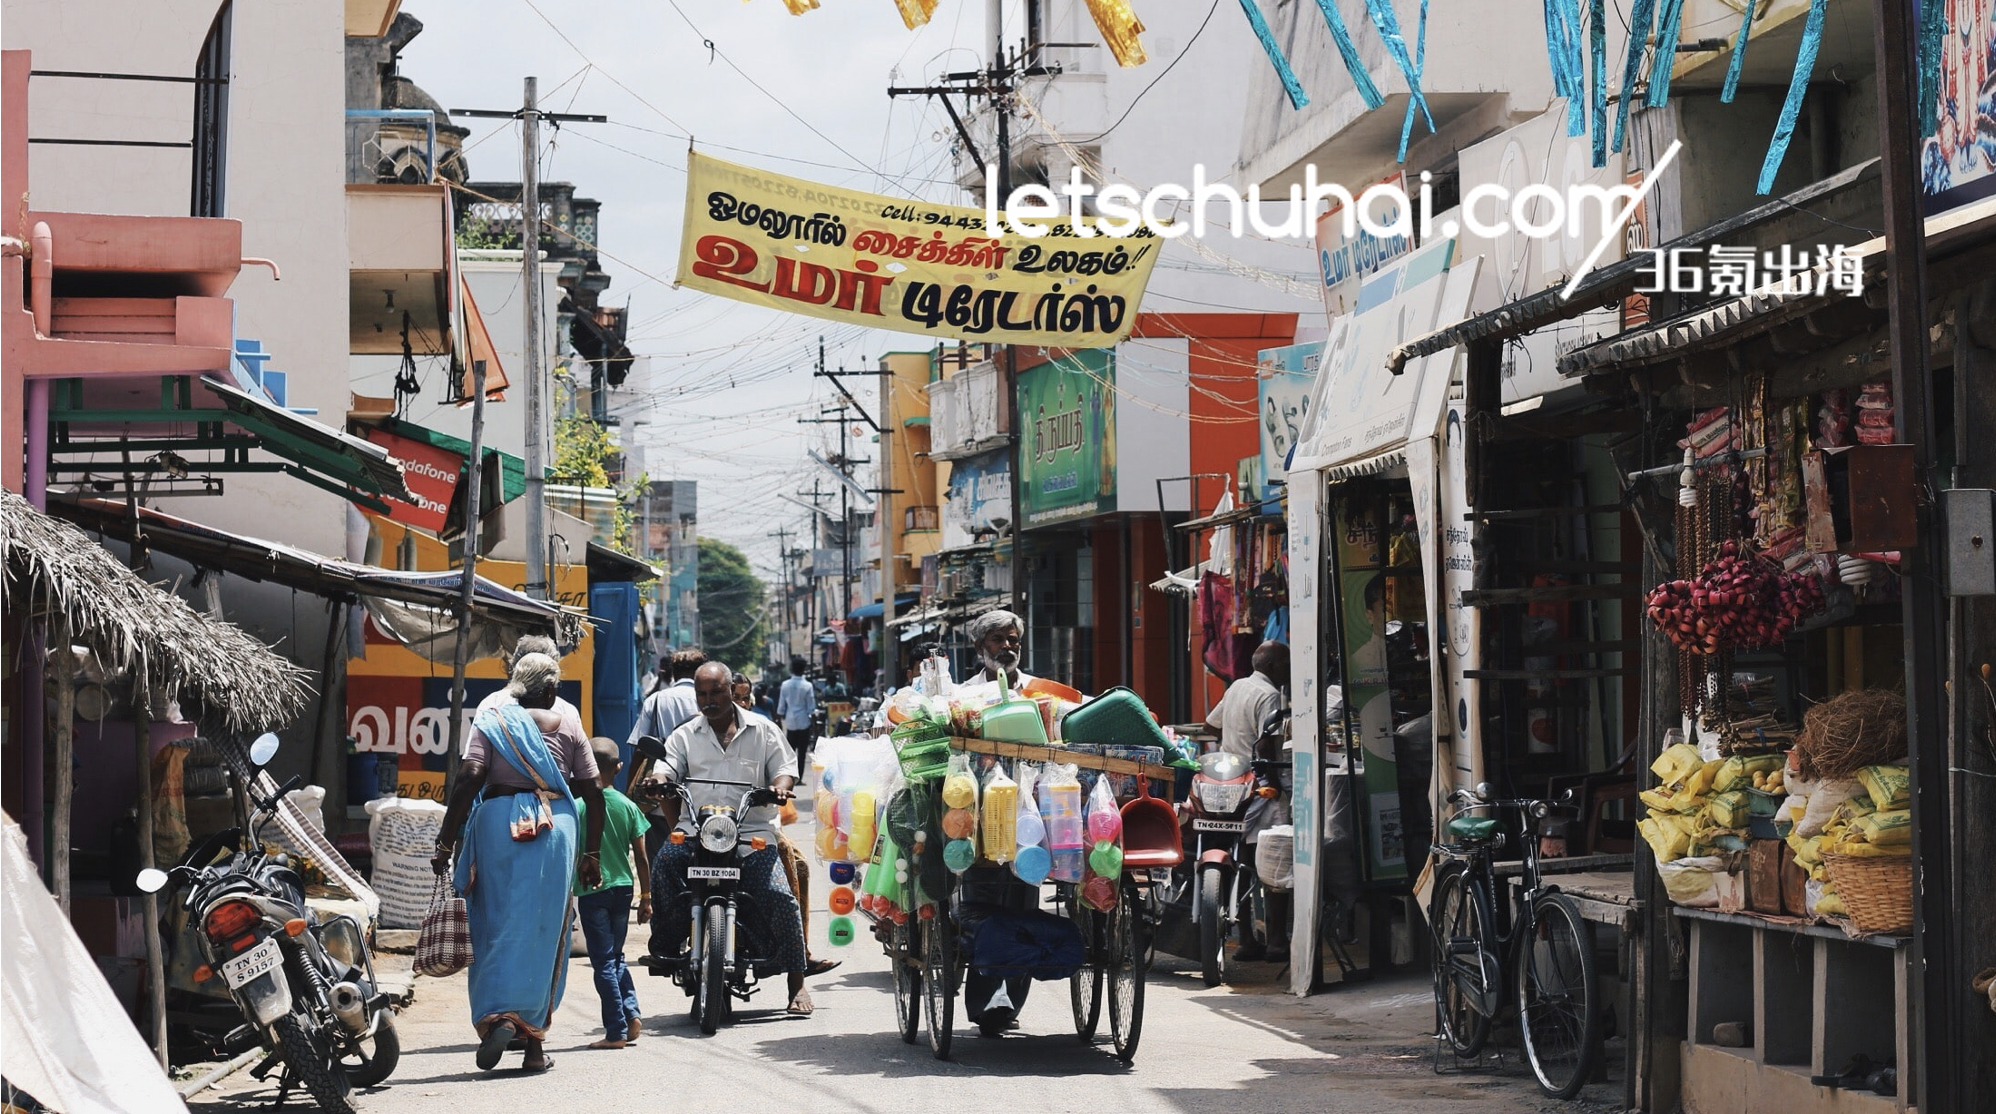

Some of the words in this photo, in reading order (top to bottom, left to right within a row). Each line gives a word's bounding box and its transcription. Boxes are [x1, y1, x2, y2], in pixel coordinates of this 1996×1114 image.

[692, 234, 896, 317] உமர்
[901, 281, 1126, 334] டிரேடர்ஸ்
[397, 457, 456, 484] odafone
[392, 861, 419, 872] WARNING
[692, 869, 702, 877] TN
[703, 869, 710, 877] 30
[235, 957, 250, 971] TN
[253, 948, 268, 962] 30
[237, 972, 245, 982] S
[247, 957, 274, 977] 9157
